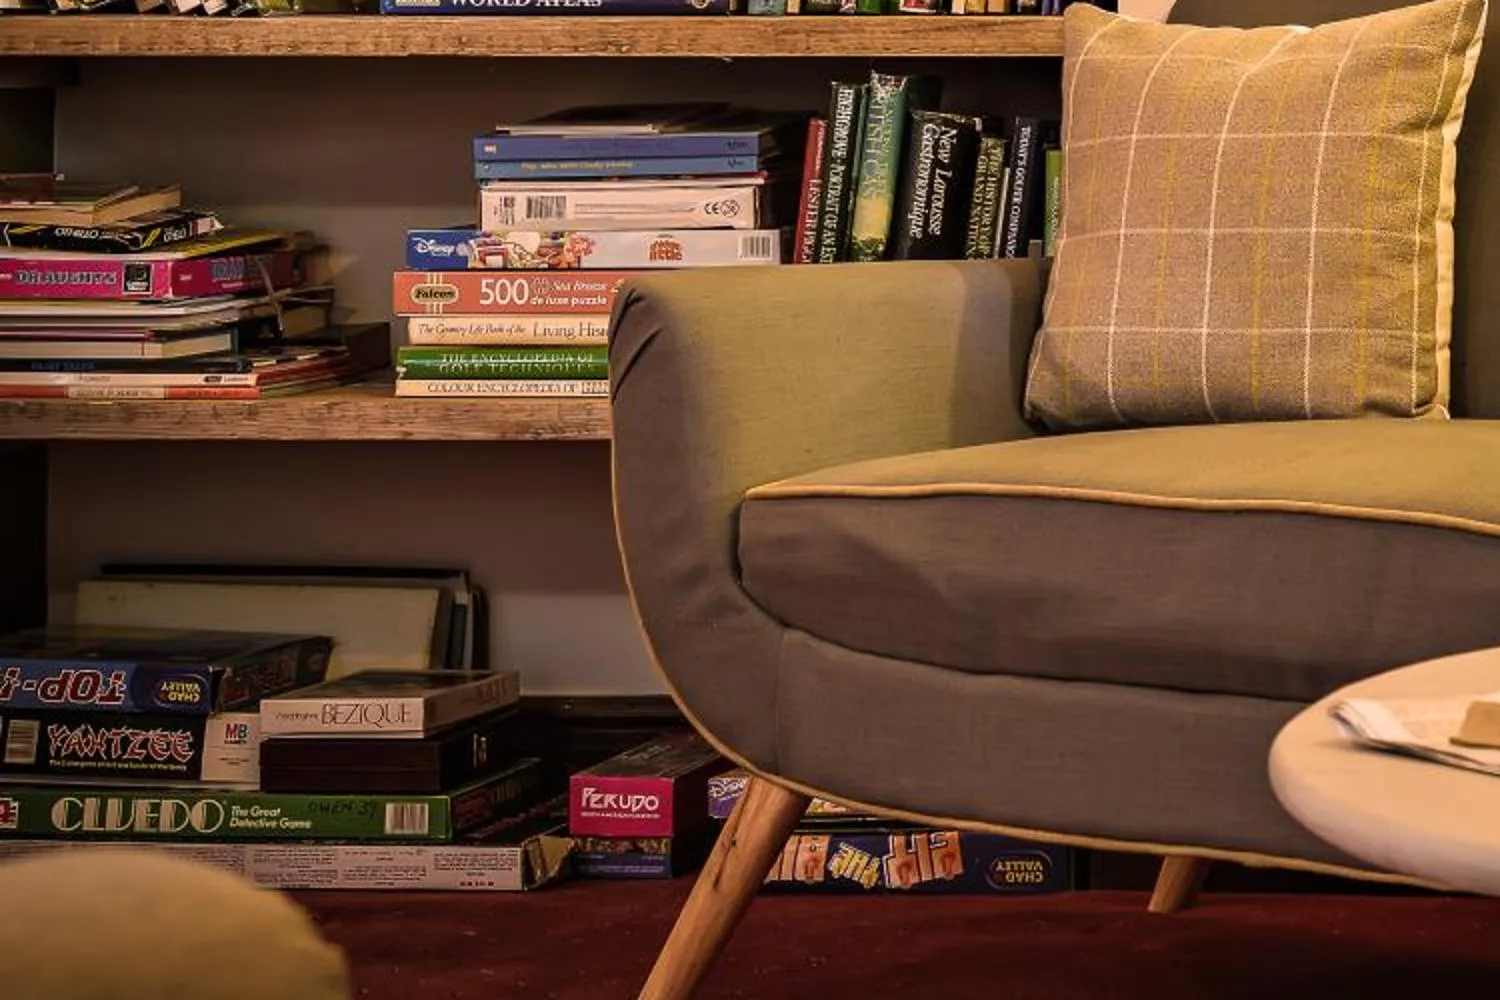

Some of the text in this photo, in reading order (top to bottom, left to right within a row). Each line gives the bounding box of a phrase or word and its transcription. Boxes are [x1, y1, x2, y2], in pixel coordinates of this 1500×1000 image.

[823, 87, 855, 246] HIGHGROVE PORTRAIT OF AN
[1012, 125, 1032, 203] TODAY'S GOLFER
[907, 123, 942, 240] Gastronomique
[928, 125, 959, 236] New Larousse
[972, 155, 989, 203] GRAND
[805, 178, 823, 229] LESTER
[977, 147, 1002, 254] THE HISTORY OF
[414, 289, 455, 300] Falcon
[479, 278, 529, 306] 500
[530, 296, 608, 307] de luxe puzzle
[418, 323, 433, 334] The
[533, 321, 577, 339] Living
[441, 353, 468, 363] THE
[471, 353, 573, 364] ENCYCLOPEDIA
[439, 363, 597, 375] GOLF TECHNIQUES
[427, 382, 474, 393] COLOUR
[477, 382, 561, 394] ENCYCLOPEDIA
[563, 382, 577, 393] OF
[168, 692, 203, 704] CHAD
[321, 703, 414, 728] BEZIQUE
[225, 723, 248, 739] MB
[47, 721, 194, 763] YAHTZEE
[580, 787, 660, 813] PERUDO
[51, 796, 226, 834] CLUEDO
[230, 804, 283, 817] The Great
[229, 817, 313, 830] Detective Game
[996, 858, 1044, 872] VALLEY
[1005, 870, 1044, 884] CHAD
